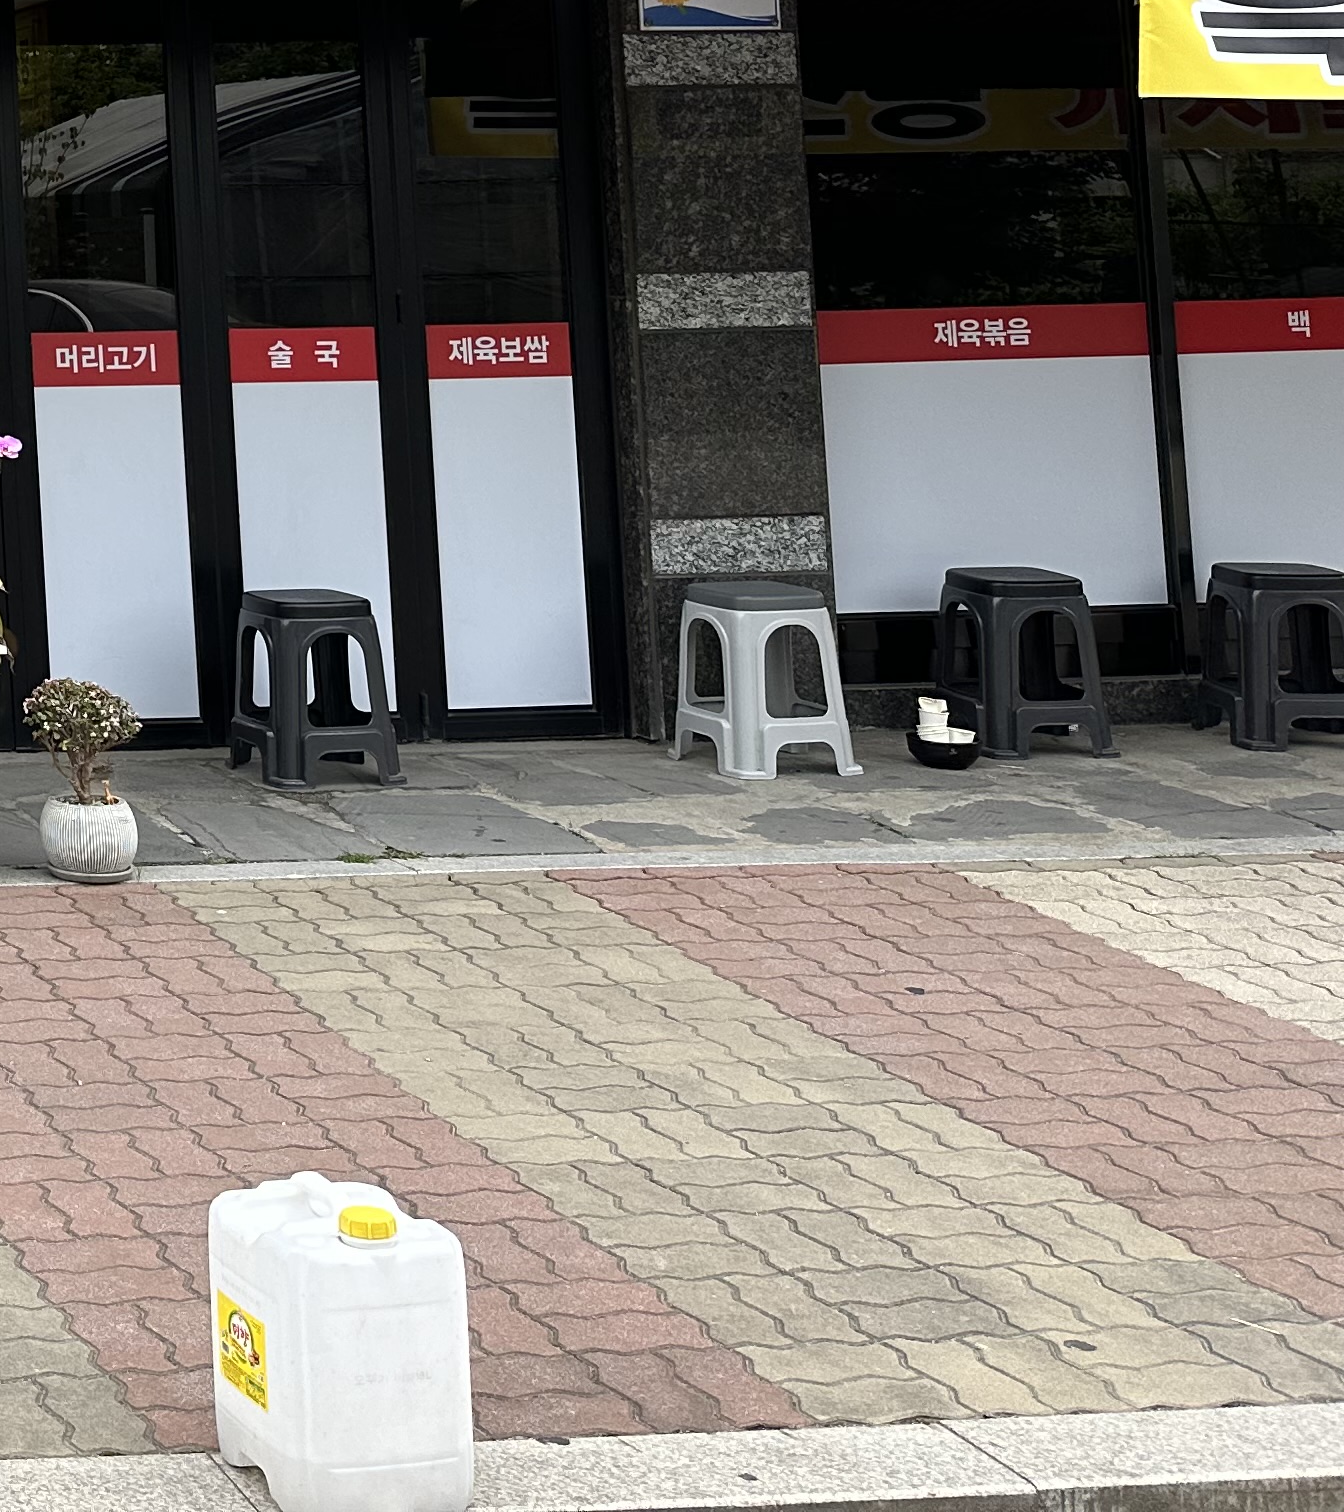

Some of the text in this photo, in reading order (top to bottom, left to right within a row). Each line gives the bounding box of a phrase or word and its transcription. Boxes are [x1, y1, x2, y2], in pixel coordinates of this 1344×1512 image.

[934, 317, 1032, 349] 제육볶음
[1287, 310, 1311, 339] 백
[55, 343, 157, 375] 머리고기
[448, 334, 549, 366] 제육보쌈
